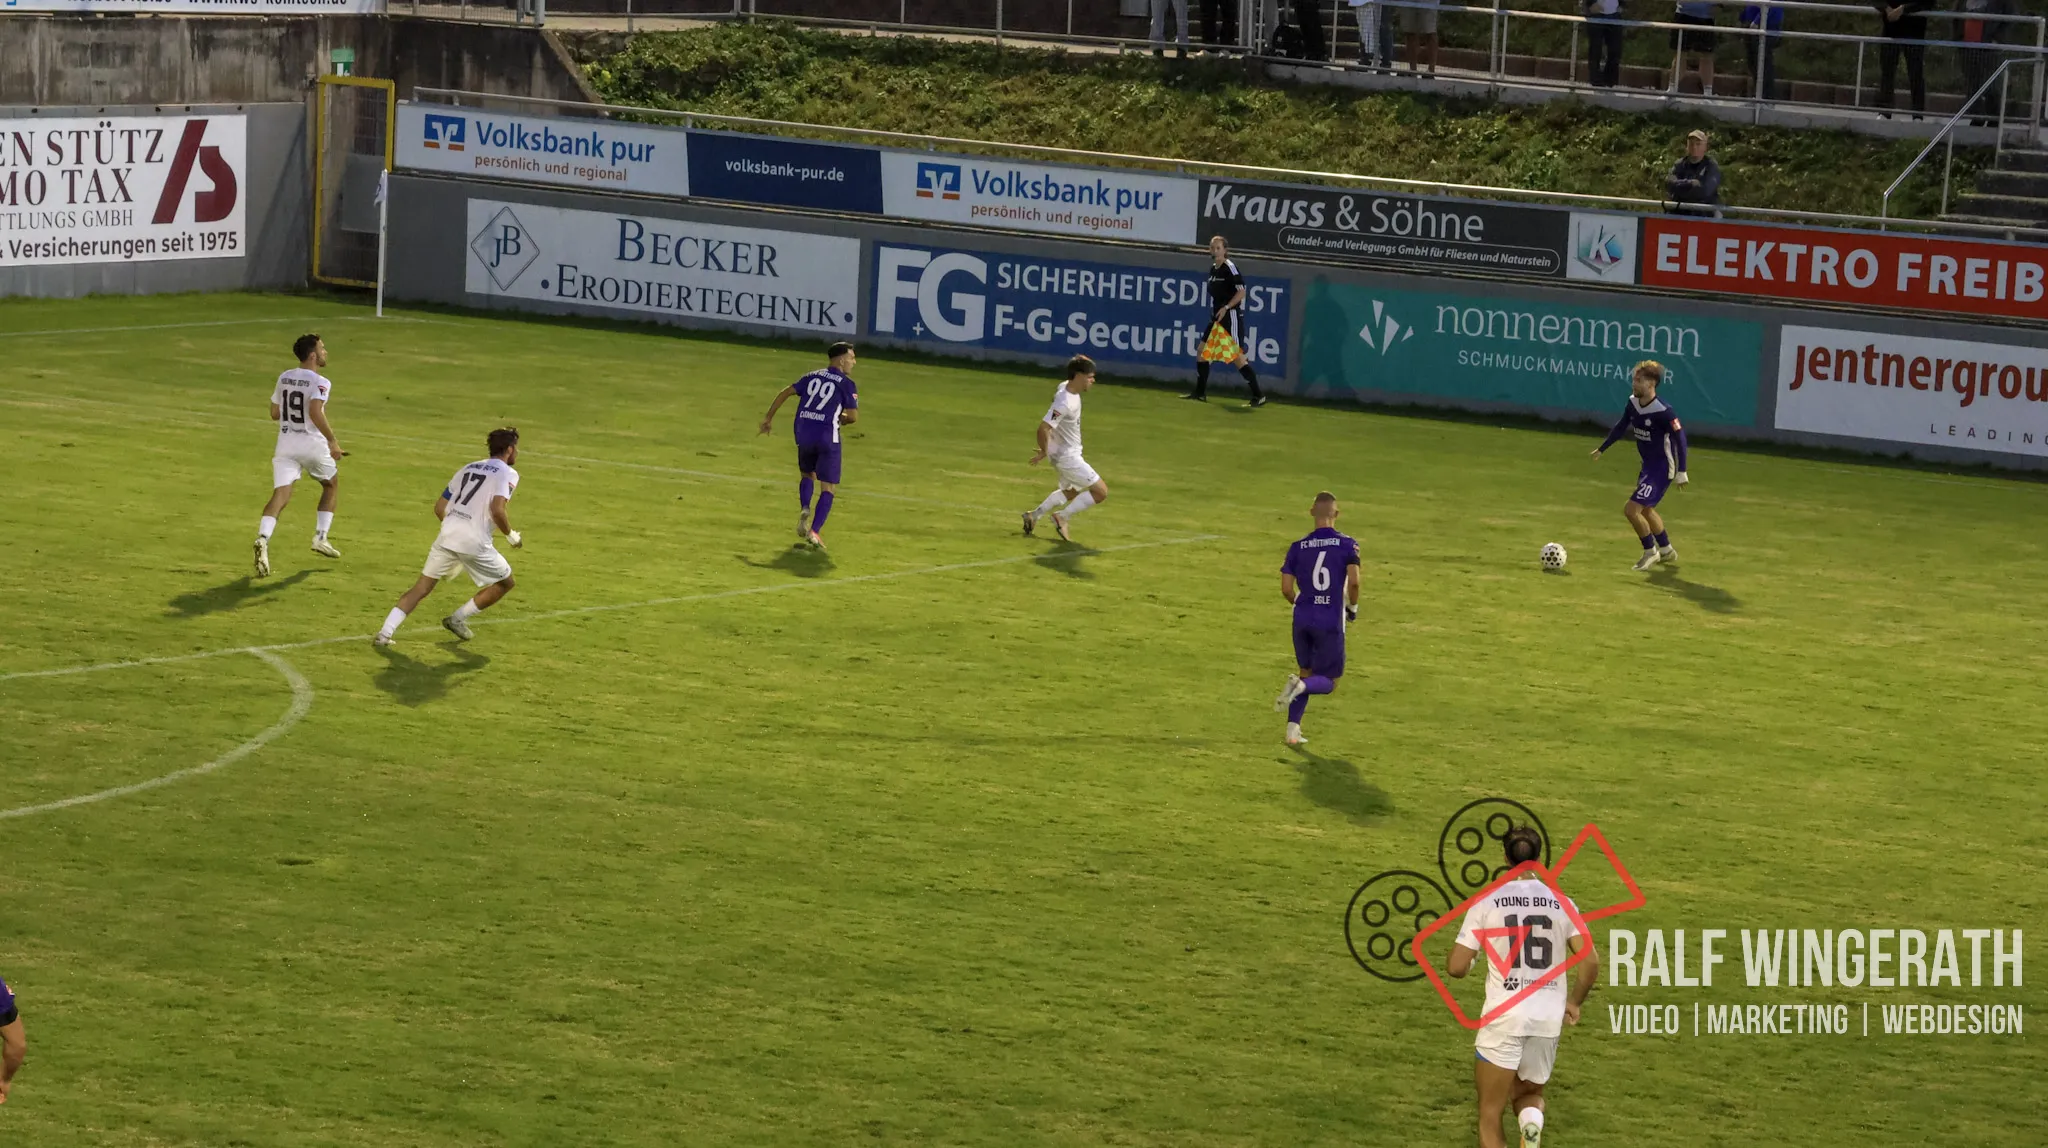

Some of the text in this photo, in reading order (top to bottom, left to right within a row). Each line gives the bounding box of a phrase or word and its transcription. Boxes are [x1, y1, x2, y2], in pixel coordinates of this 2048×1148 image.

[0, 121, 163, 167] N STÜTZ
[476, 120, 656, 165] Volksbank pur
[474, 153, 627, 182] persönlich und regional
[725, 158, 845, 182] volksbank-pur.de
[61, 168, 133, 204] TAX
[971, 169, 1164, 215] Volksbank pur
[83, 209, 133, 228] GMBH
[971, 202, 1134, 231] persönlich und regional
[1203, 183, 1485, 242] Krauss & Söhne
[9, 236, 156, 259] Versicherungen
[161, 231, 194, 252] seit
[199, 231, 237, 251] 1975
[615, 218, 780, 279] BECKER
[1286, 234, 1551, 267] Handel- und Verlegungs GmbH für Fliesen und Naturstein
[1656, 233, 2045, 302] ELEKTRO FREIB
[555, 263, 838, 328] ERODIERTECHNIK
[998, 262, 1284, 315] SICHERHEITSDIST
[994, 304, 1281, 364] F-G-Securitde
[1434, 304, 1702, 358] nonnenmann
[1458, 350, 1674, 385] SCHMUCKMANUFAKR
[282, 389, 305, 424] 19
[804, 377, 836, 411] 99
[454, 472, 487, 506] 17
[1637, 483, 1653, 498] 20
[1312, 551, 1330, 591] 6
[1493, 896, 1561, 910] YOUNG BOYS
[1504, 914, 1553, 969] 16
